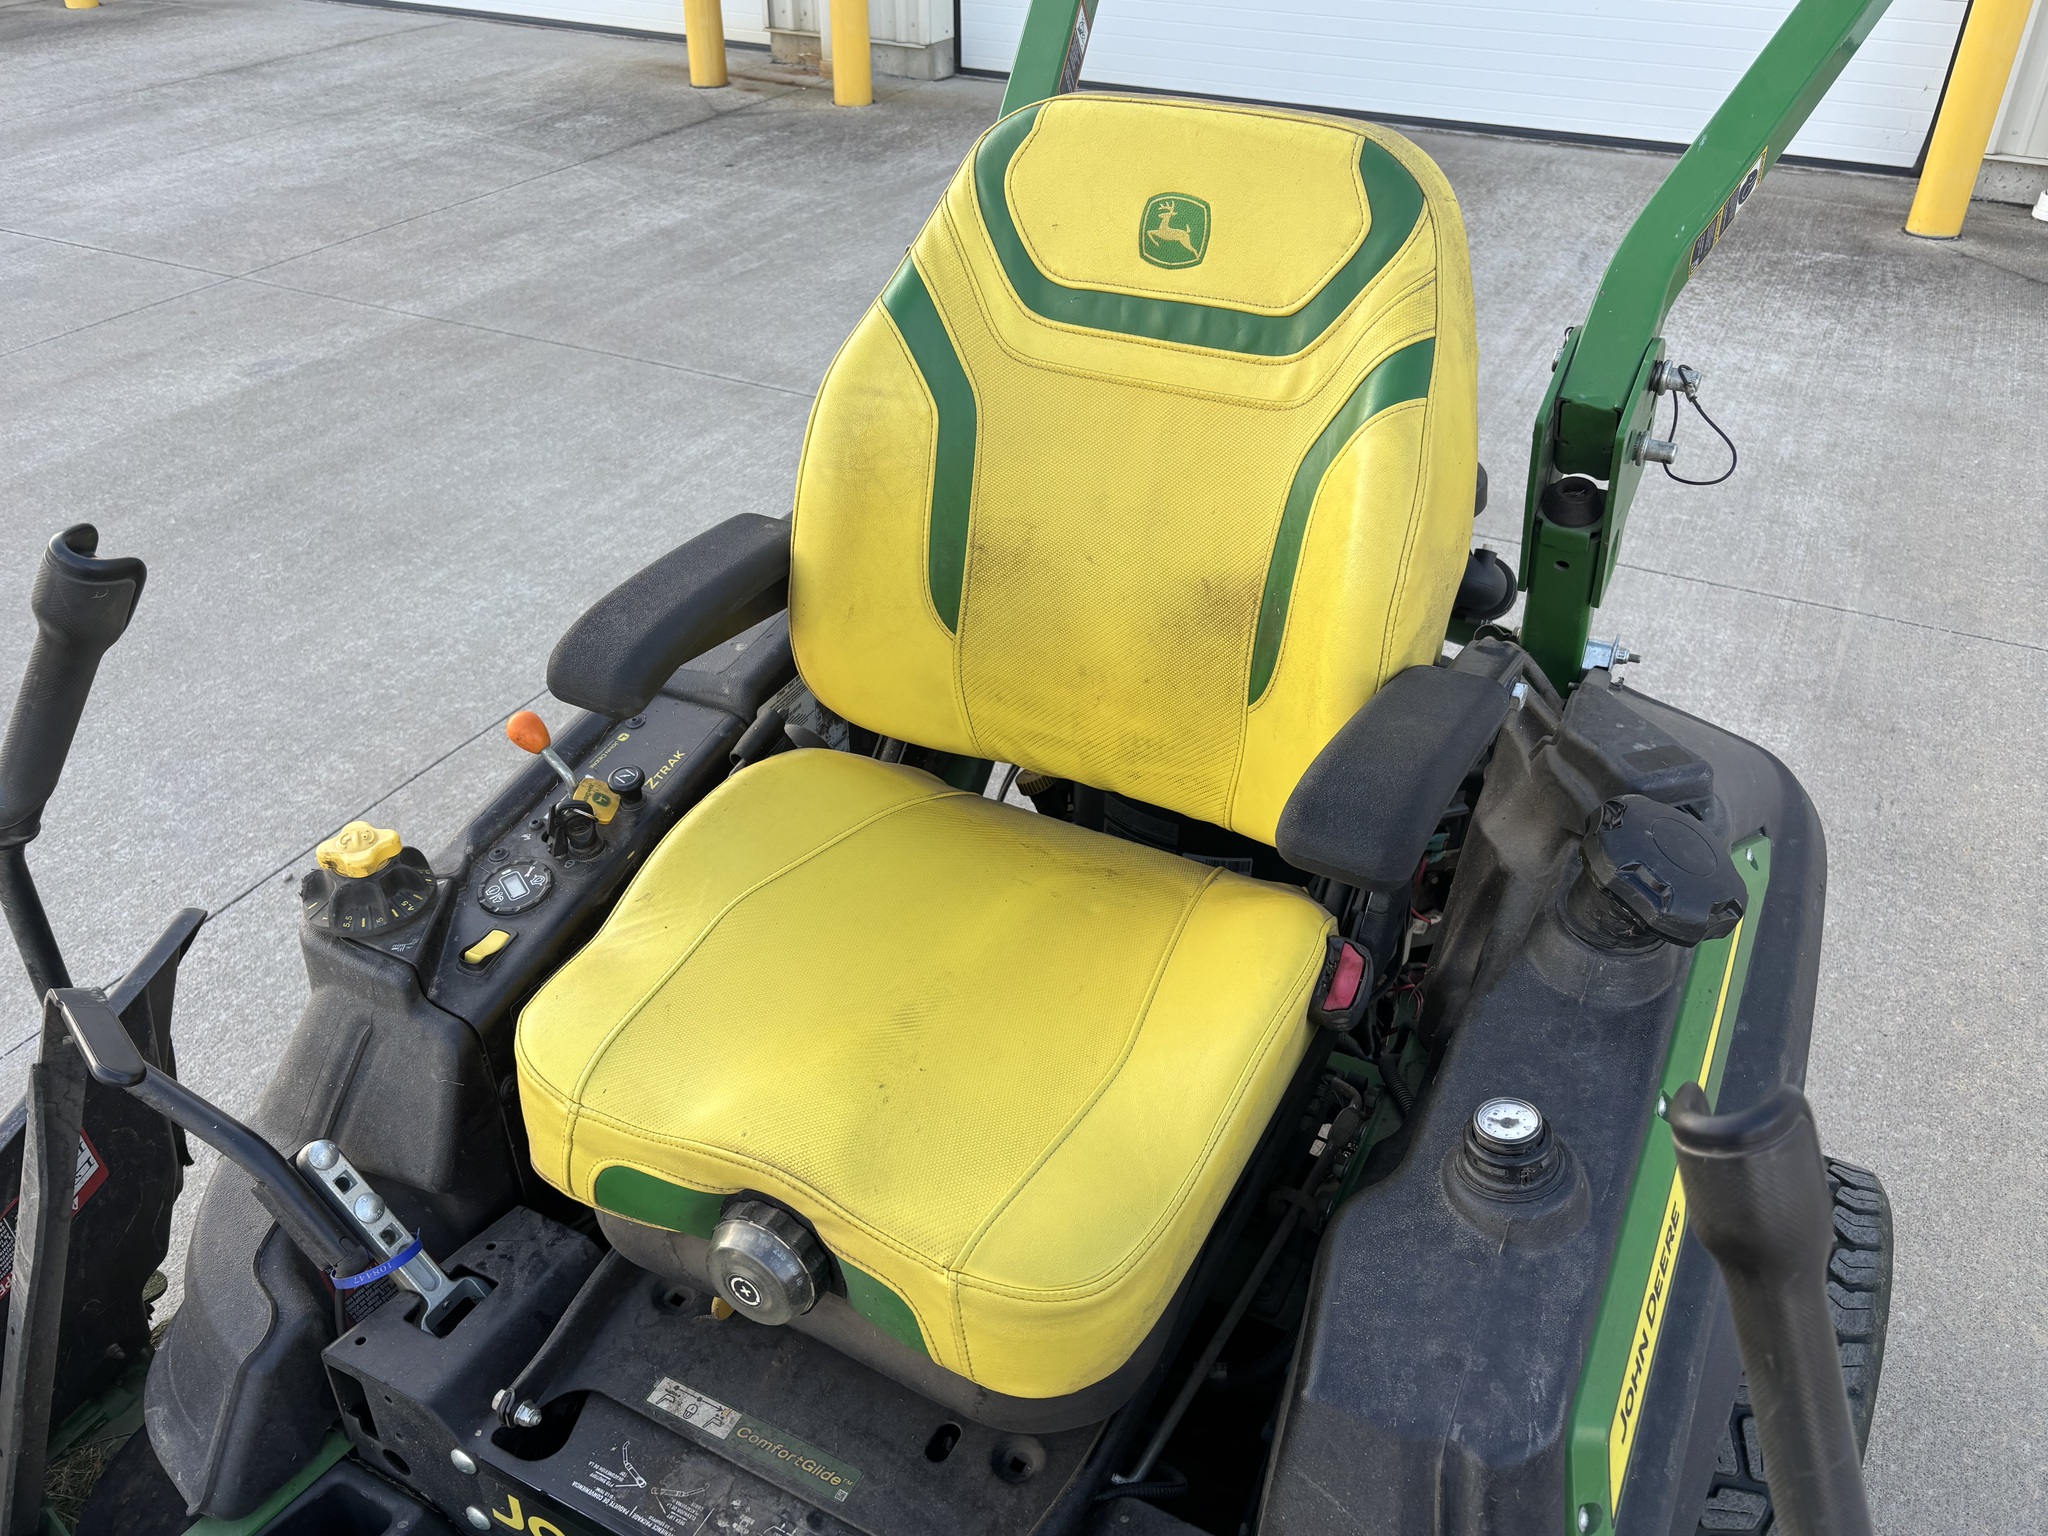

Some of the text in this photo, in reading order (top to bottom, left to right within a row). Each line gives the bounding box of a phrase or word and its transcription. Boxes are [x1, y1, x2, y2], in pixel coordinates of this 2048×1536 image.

[644, 751, 686, 791] ZTRAK
[343, 915, 352, 928] 5.5
[354, 1262, 391, 1283] 108447
[769, 1256, 781, 1269] 105
[772, 1246, 788, 1261] 235
[786, 1261, 800, 1276] 280
[1619, 1200, 1680, 1446] JOHN DEERE
[571, 1480, 630, 1515] PAQUETE DE CONVENIENCIA
[632, 1513, 653, 1527] PACKAGE
